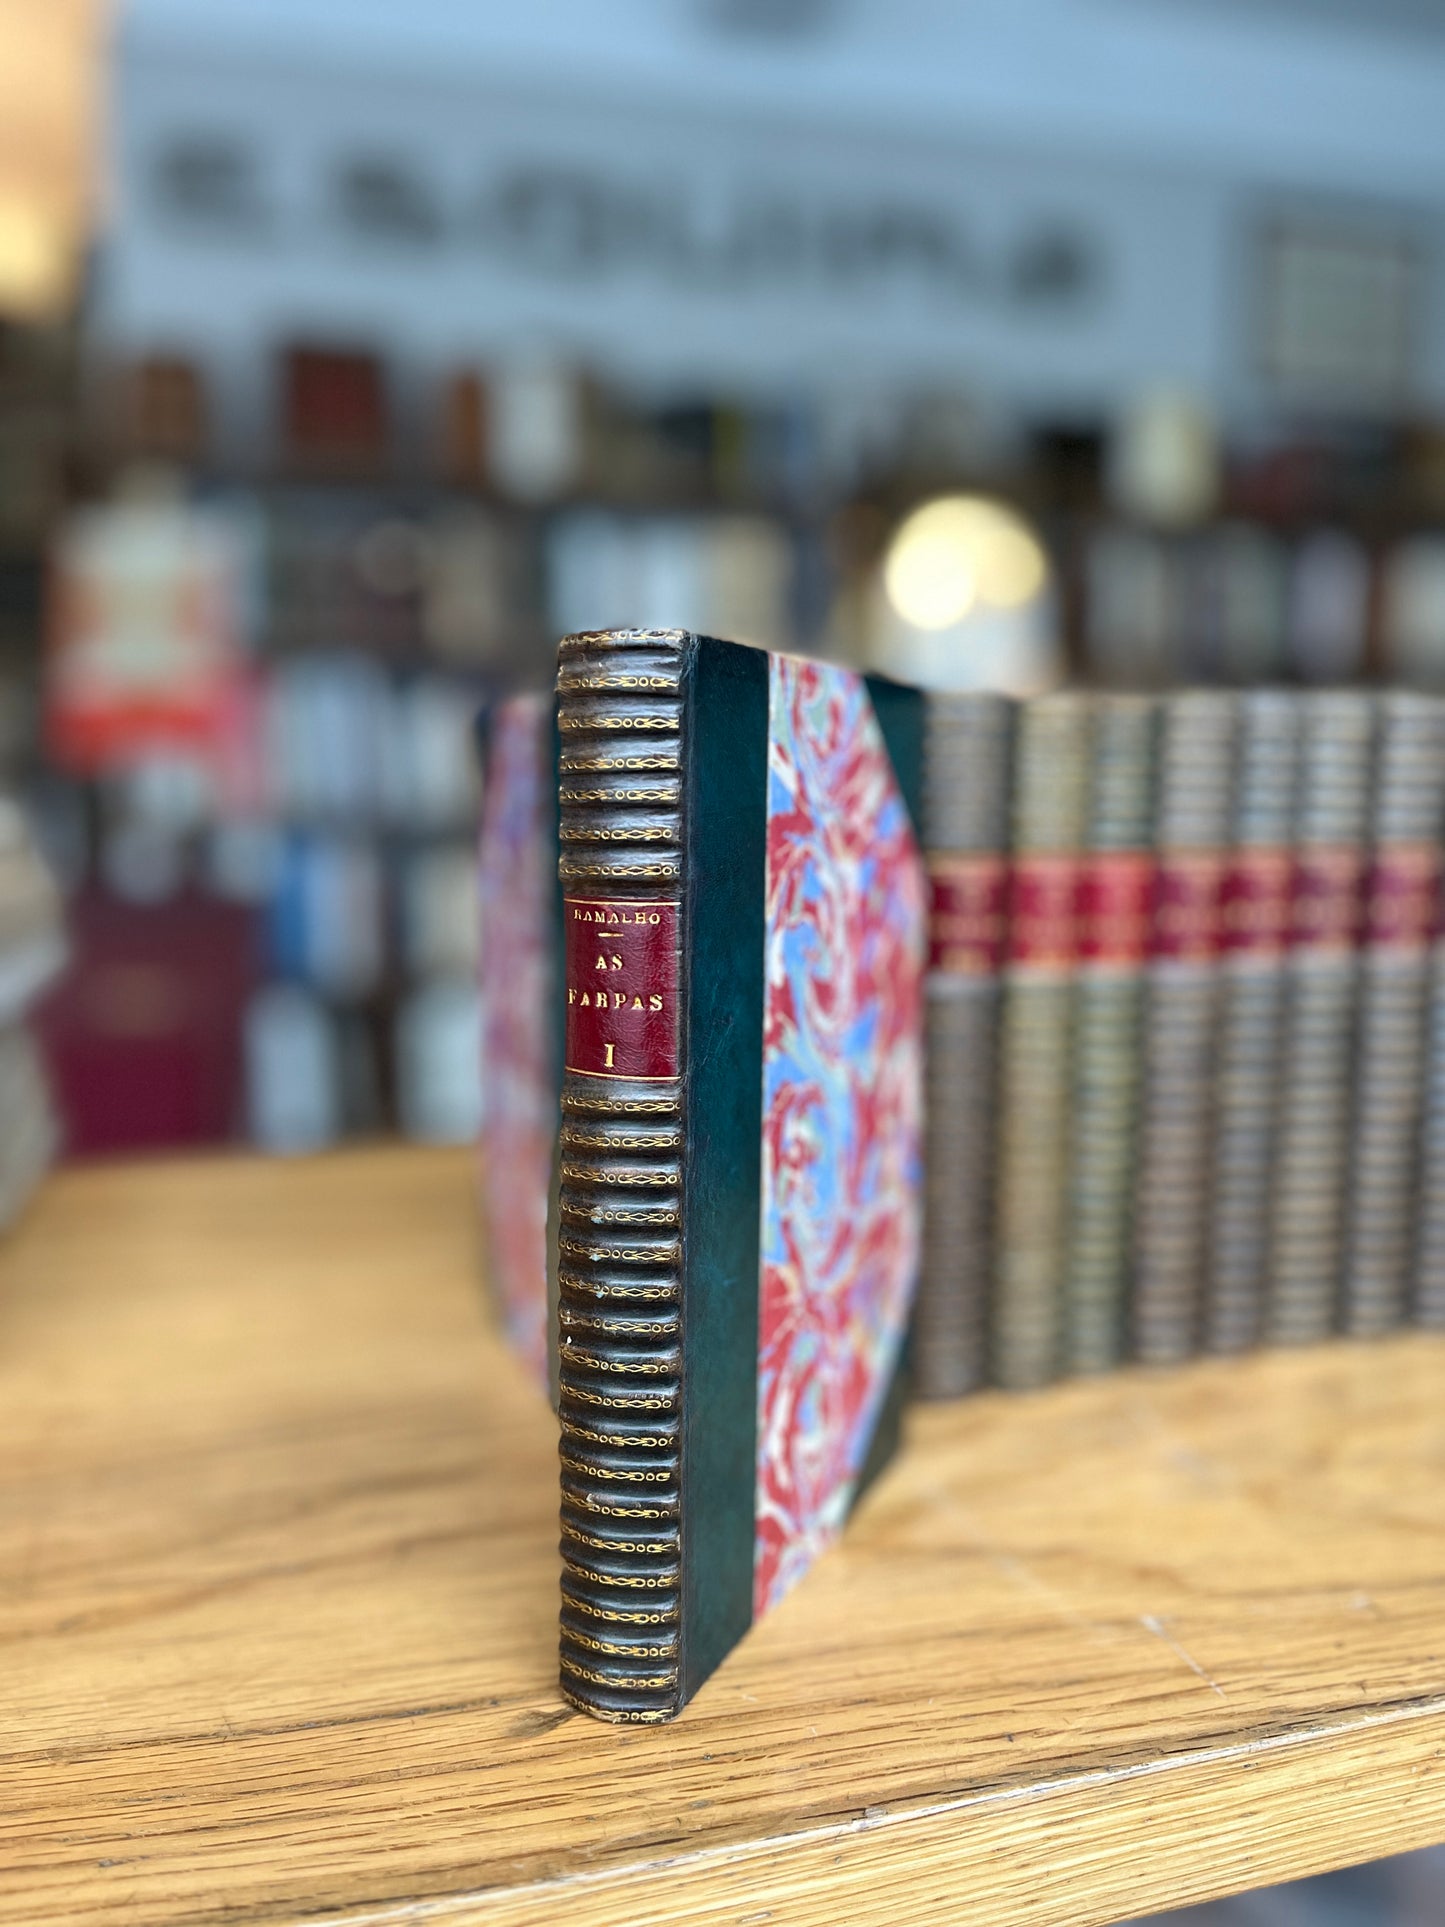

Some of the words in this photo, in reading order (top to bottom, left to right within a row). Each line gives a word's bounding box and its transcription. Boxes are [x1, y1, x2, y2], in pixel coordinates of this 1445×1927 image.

[573, 908, 661, 925] RAMALHO
[595, 954, 623, 970] AS
[568, 988, 663, 1011] FARPAS
[604, 1043, 616, 1067] I
